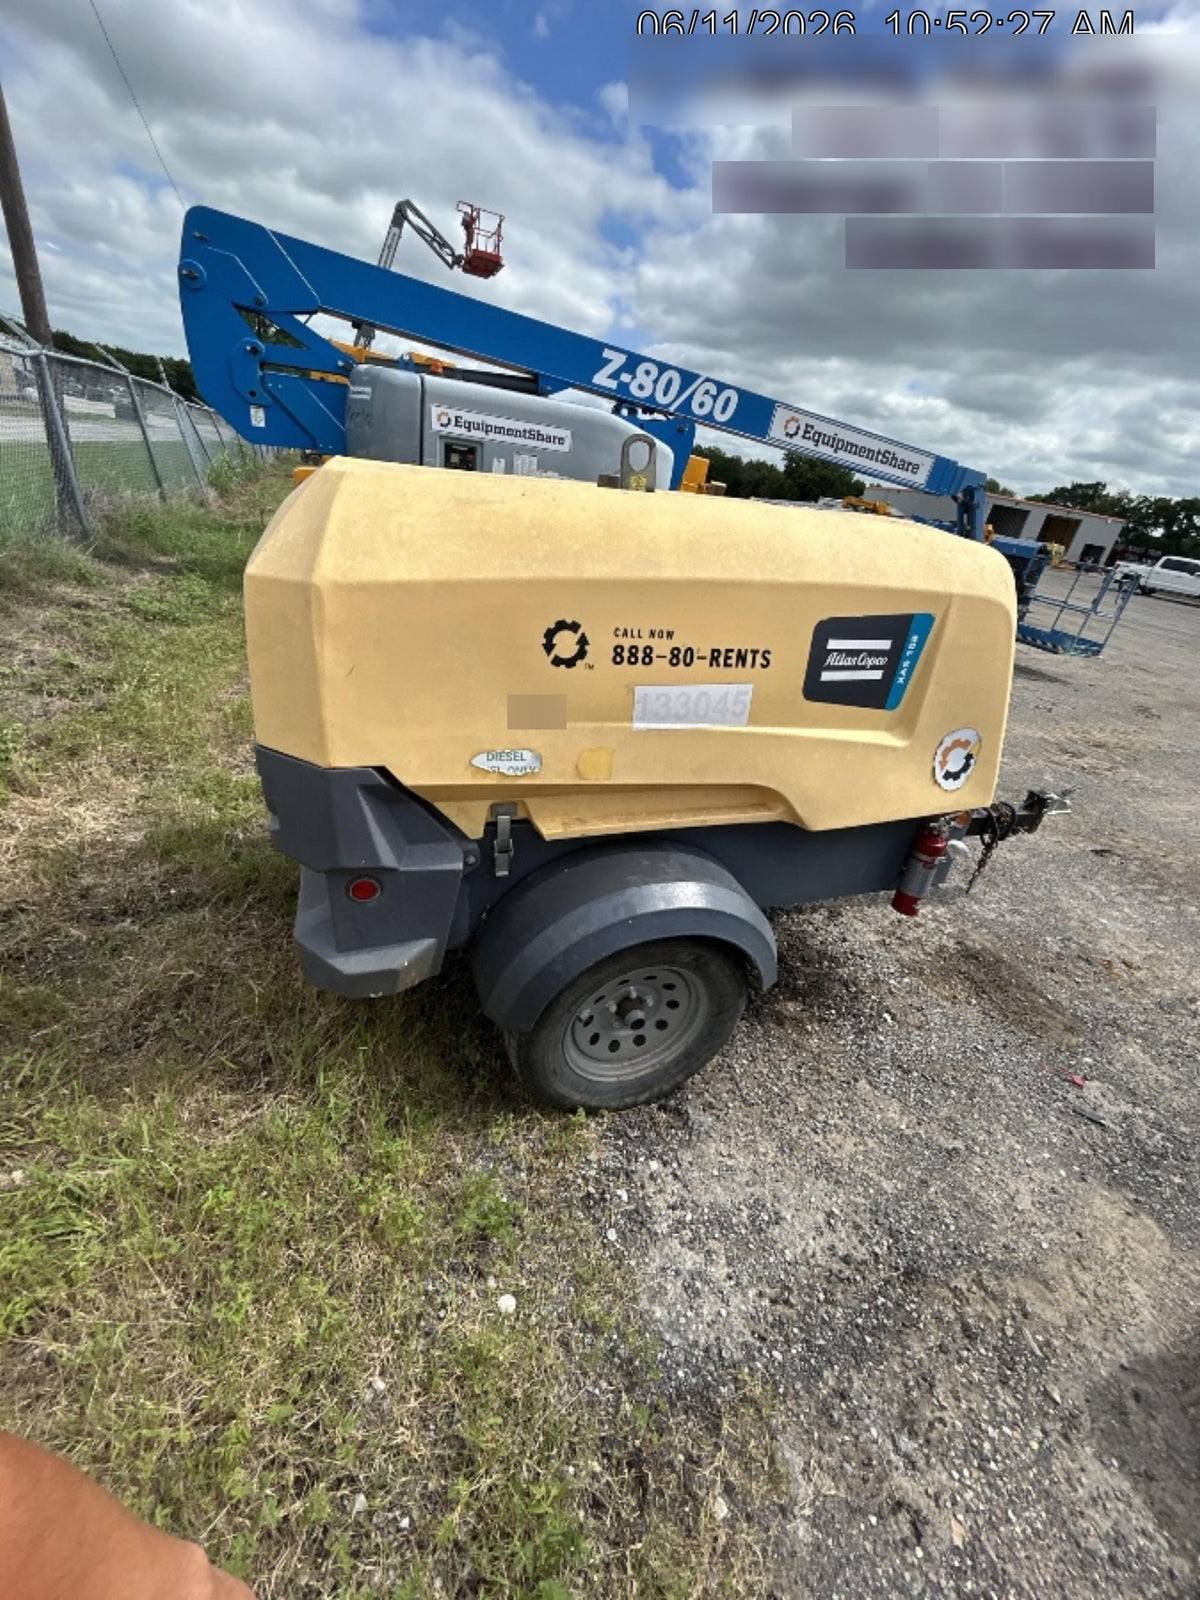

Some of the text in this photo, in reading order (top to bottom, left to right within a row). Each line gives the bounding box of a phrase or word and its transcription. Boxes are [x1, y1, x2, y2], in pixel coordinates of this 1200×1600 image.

[591, 347, 739, 422] Z-80/60
[453, 415, 566, 446] EquipmentShare
[801, 423, 920, 476] EquipmentShare
[613, 626, 675, 640] CALL NOW
[612, 644, 772, 669] 888-80-RENTS
[635, 690, 750, 722] 133045
[486, 751, 527, 762] DIESEL
